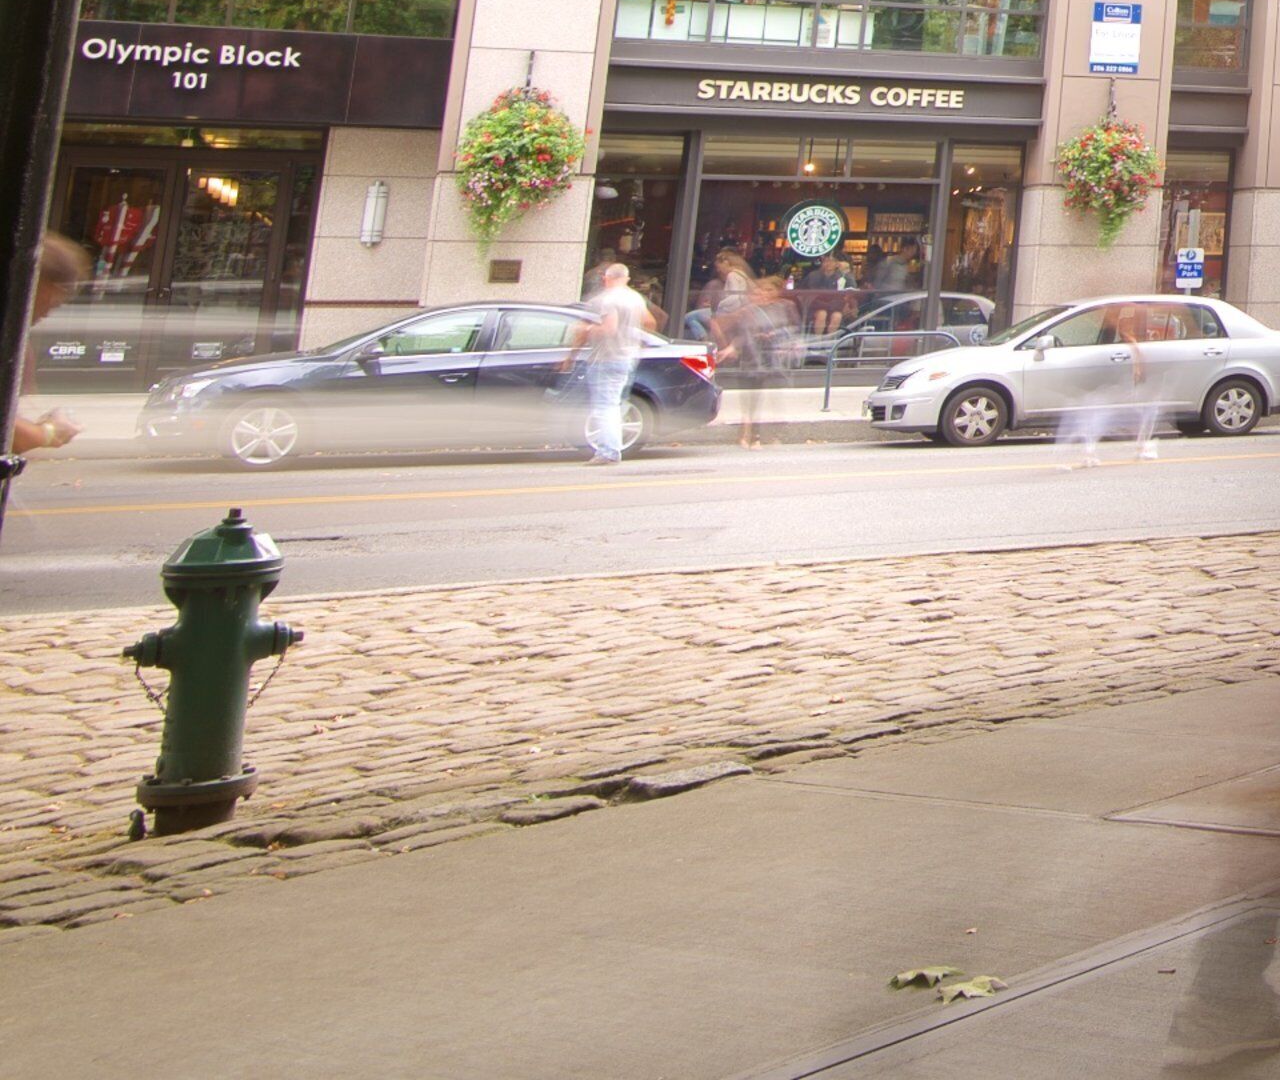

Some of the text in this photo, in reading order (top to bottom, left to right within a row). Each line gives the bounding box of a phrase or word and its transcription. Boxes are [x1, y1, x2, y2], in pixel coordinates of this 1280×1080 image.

[82, 38, 302, 68] Olympic Block
[171, 71, 208, 89] 101
[697, 79, 965, 109] STARBUCKS COFFEE
[791, 208, 840, 231] STARBUCKS
[794, 239, 832, 255] COFFEE
[1178, 264, 1192, 272] Pay
[49, 345, 86, 356] CBRE
